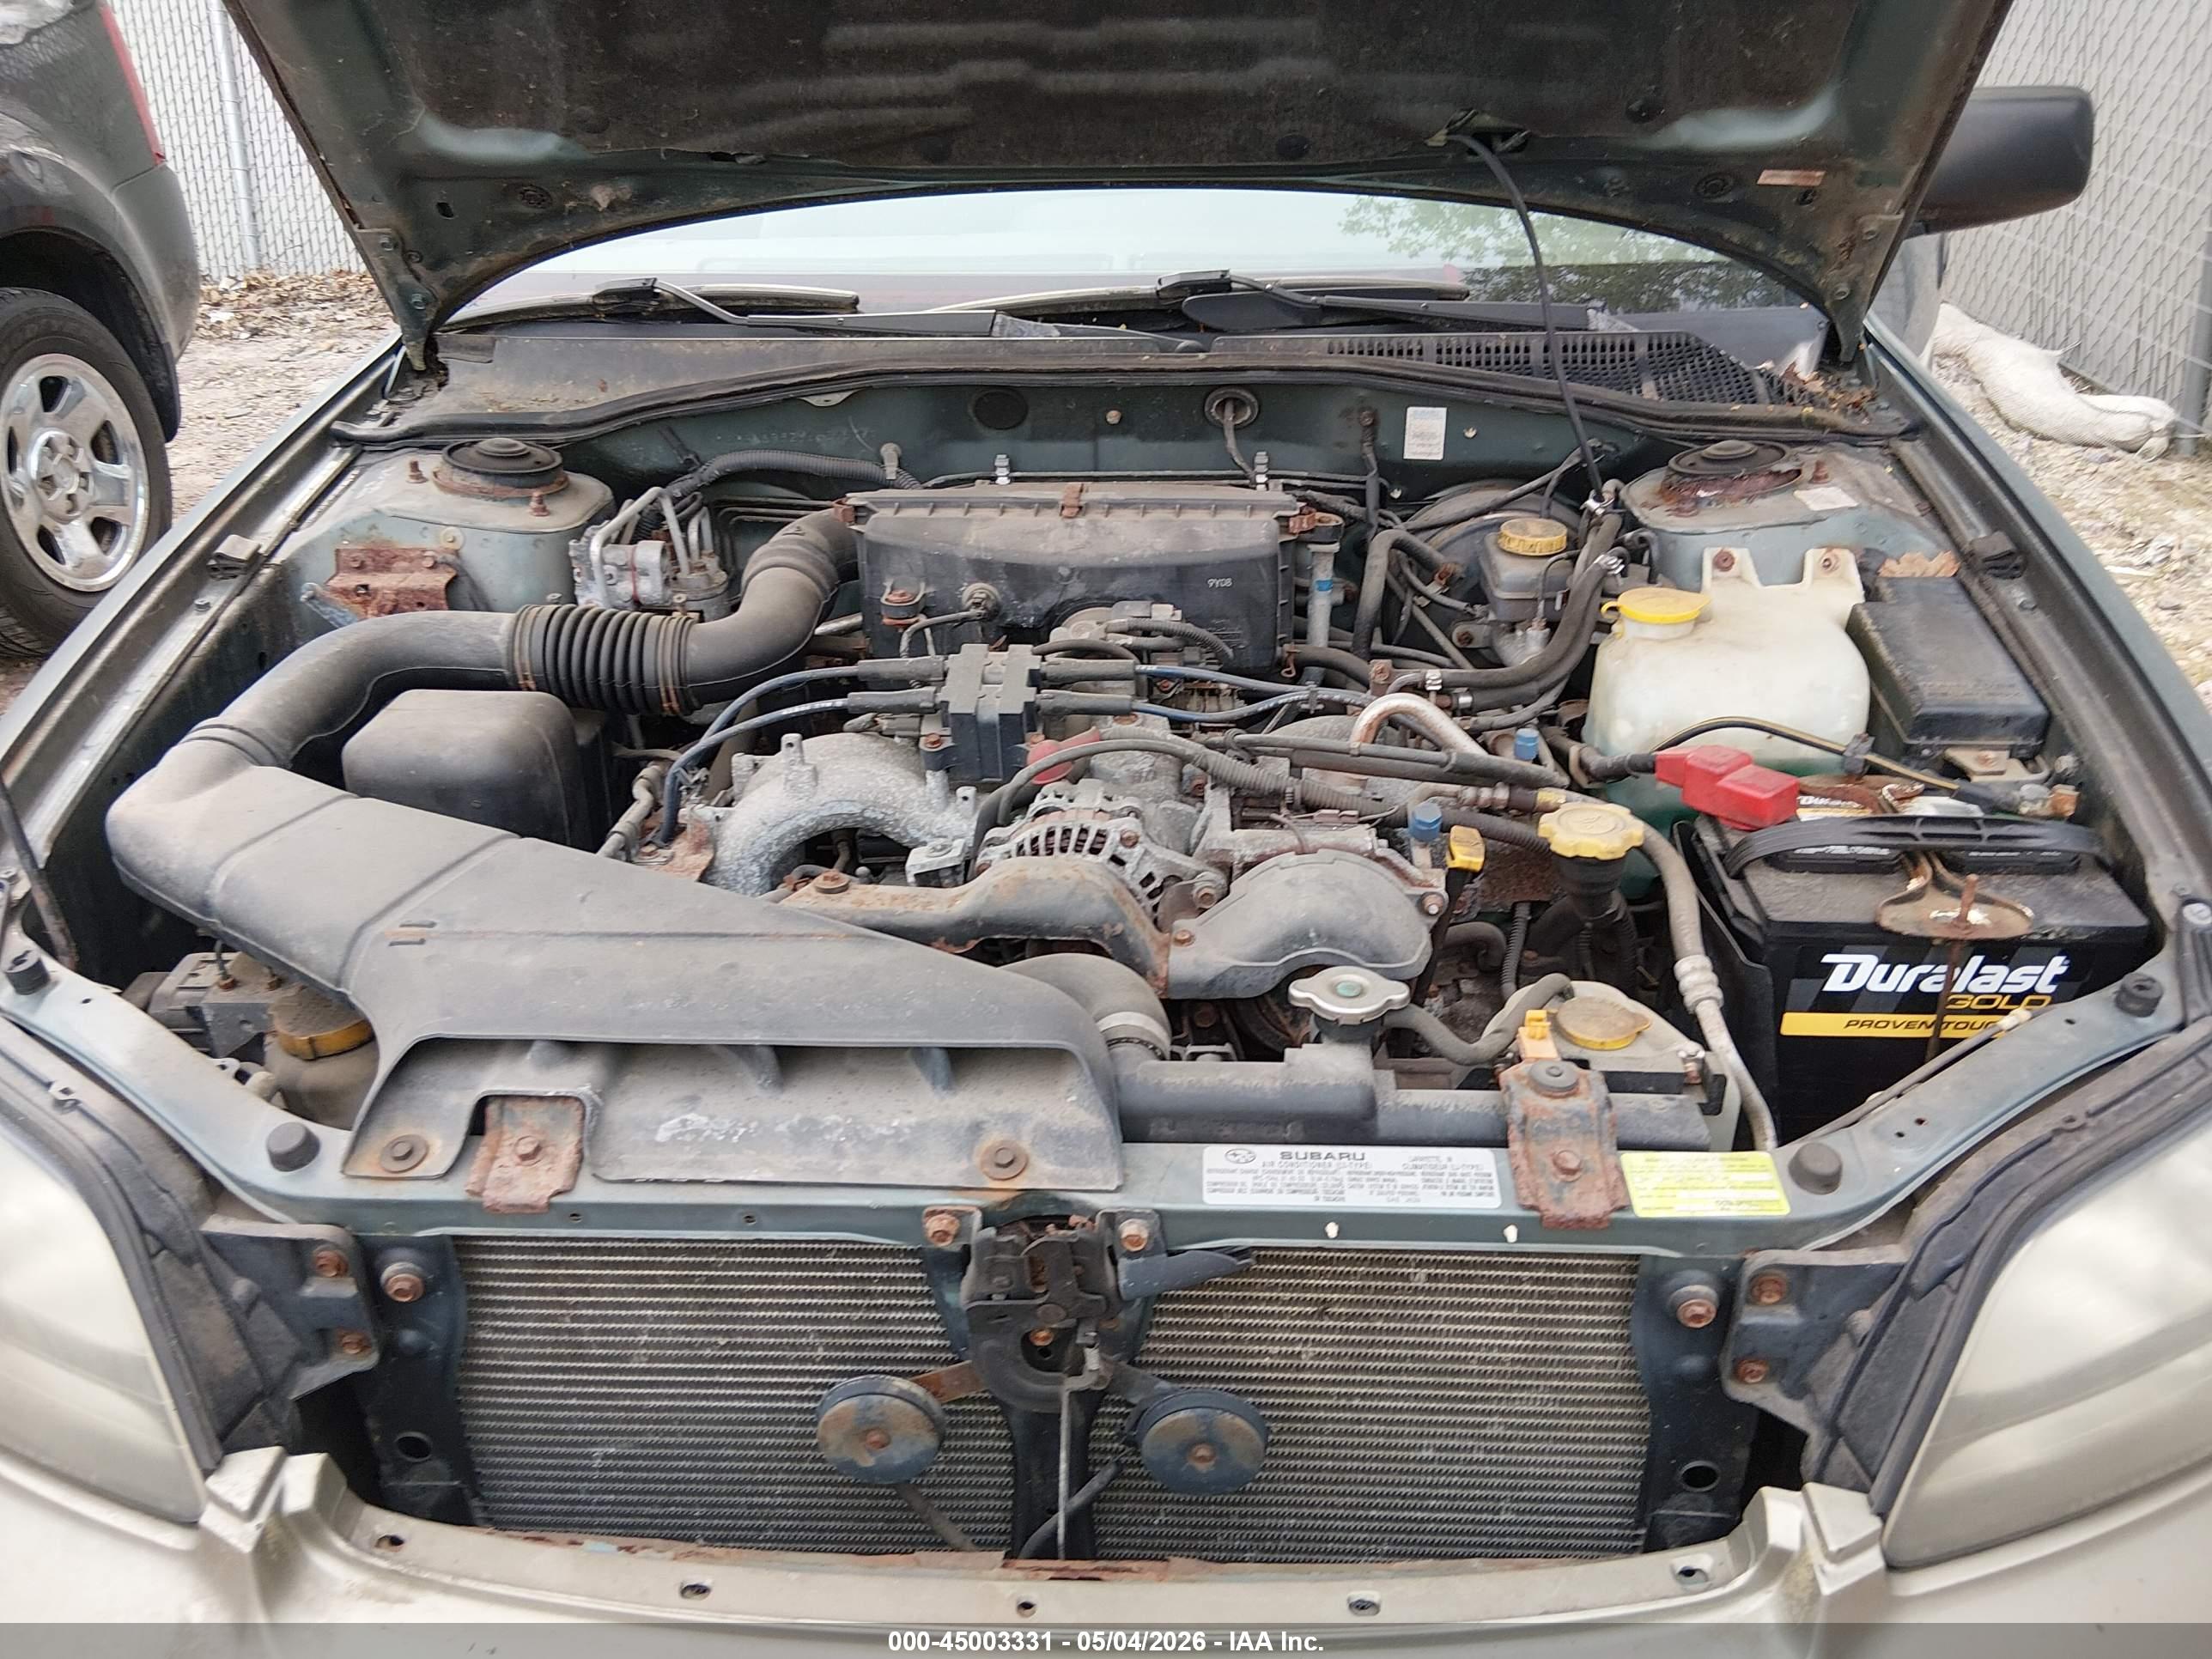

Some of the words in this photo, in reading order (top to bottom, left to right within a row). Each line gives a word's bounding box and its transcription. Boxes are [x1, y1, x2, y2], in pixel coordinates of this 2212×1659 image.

[1820, 953, 2069, 994] Duralast
[1945, 994, 2052, 1010] GOLD
[1844, 1019, 1934, 1030] PROVEN
[1279, 1151, 1365, 1161] SUBARU
